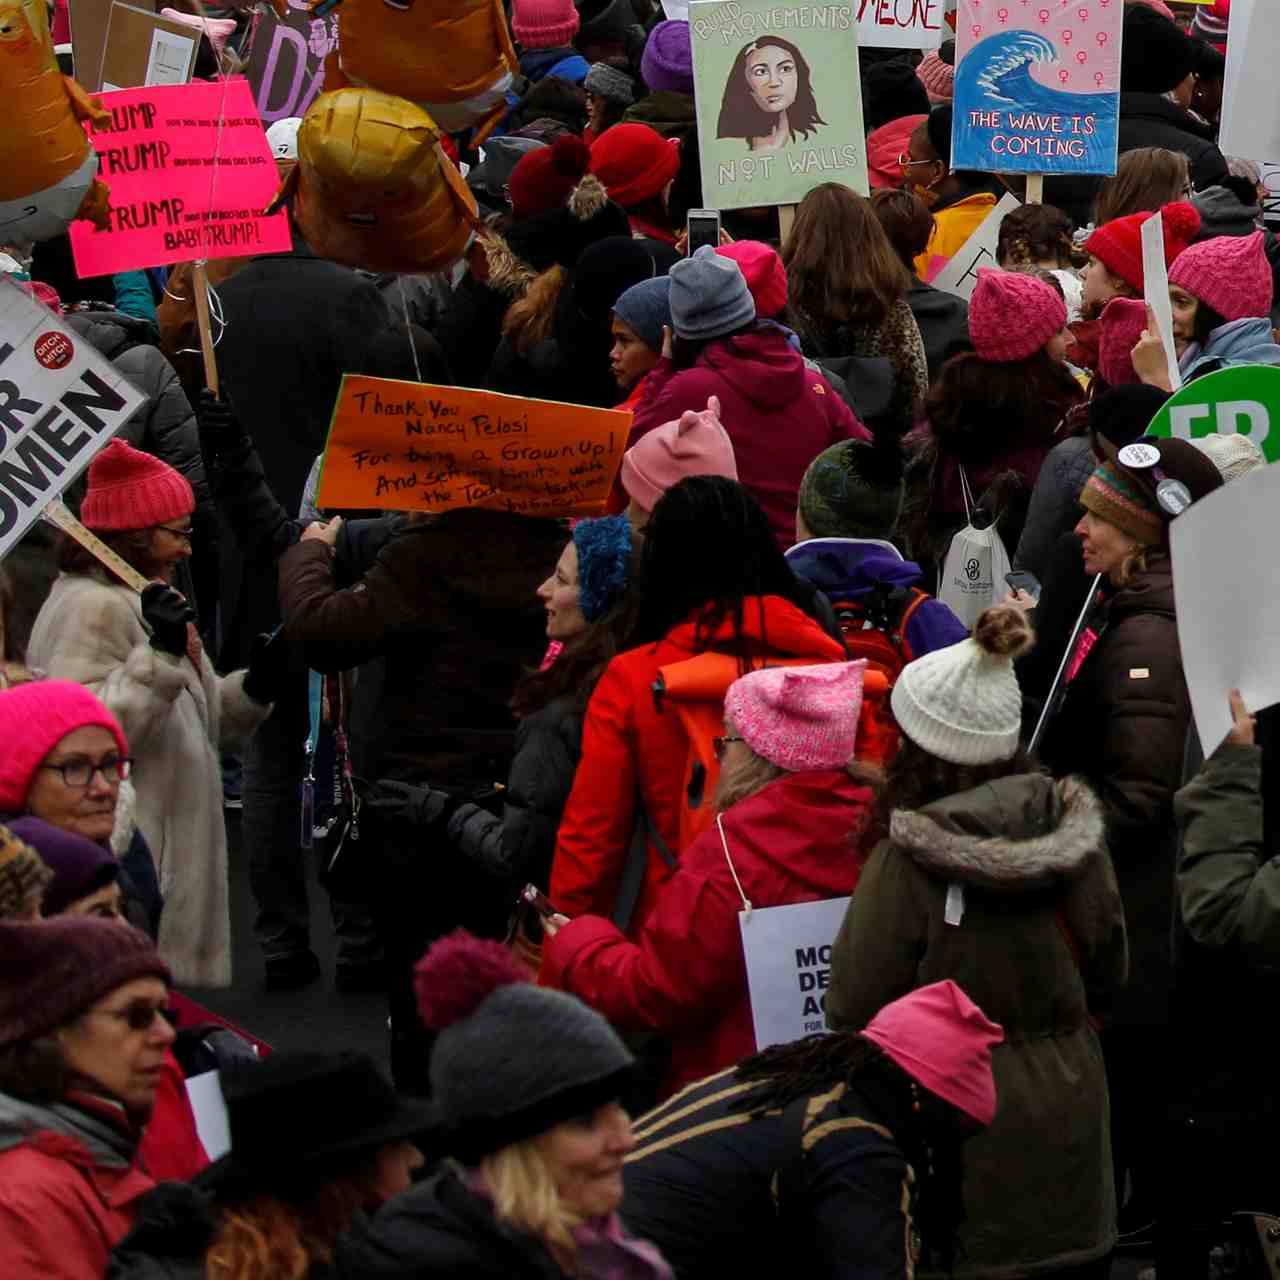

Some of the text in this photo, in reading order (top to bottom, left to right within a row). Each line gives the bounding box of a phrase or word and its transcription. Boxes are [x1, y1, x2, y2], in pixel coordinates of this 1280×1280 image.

[968, 109, 1096, 135] THE WAVE IS
[96, 140, 172, 176] TRUMP
[991, 134, 1086, 158] COMING
[718, 142, 858, 185] NOT WALLS
[353, 390, 460, 417] Thank You
[405, 420, 466, 443] Nancy
[351, 451, 392, 471] For
